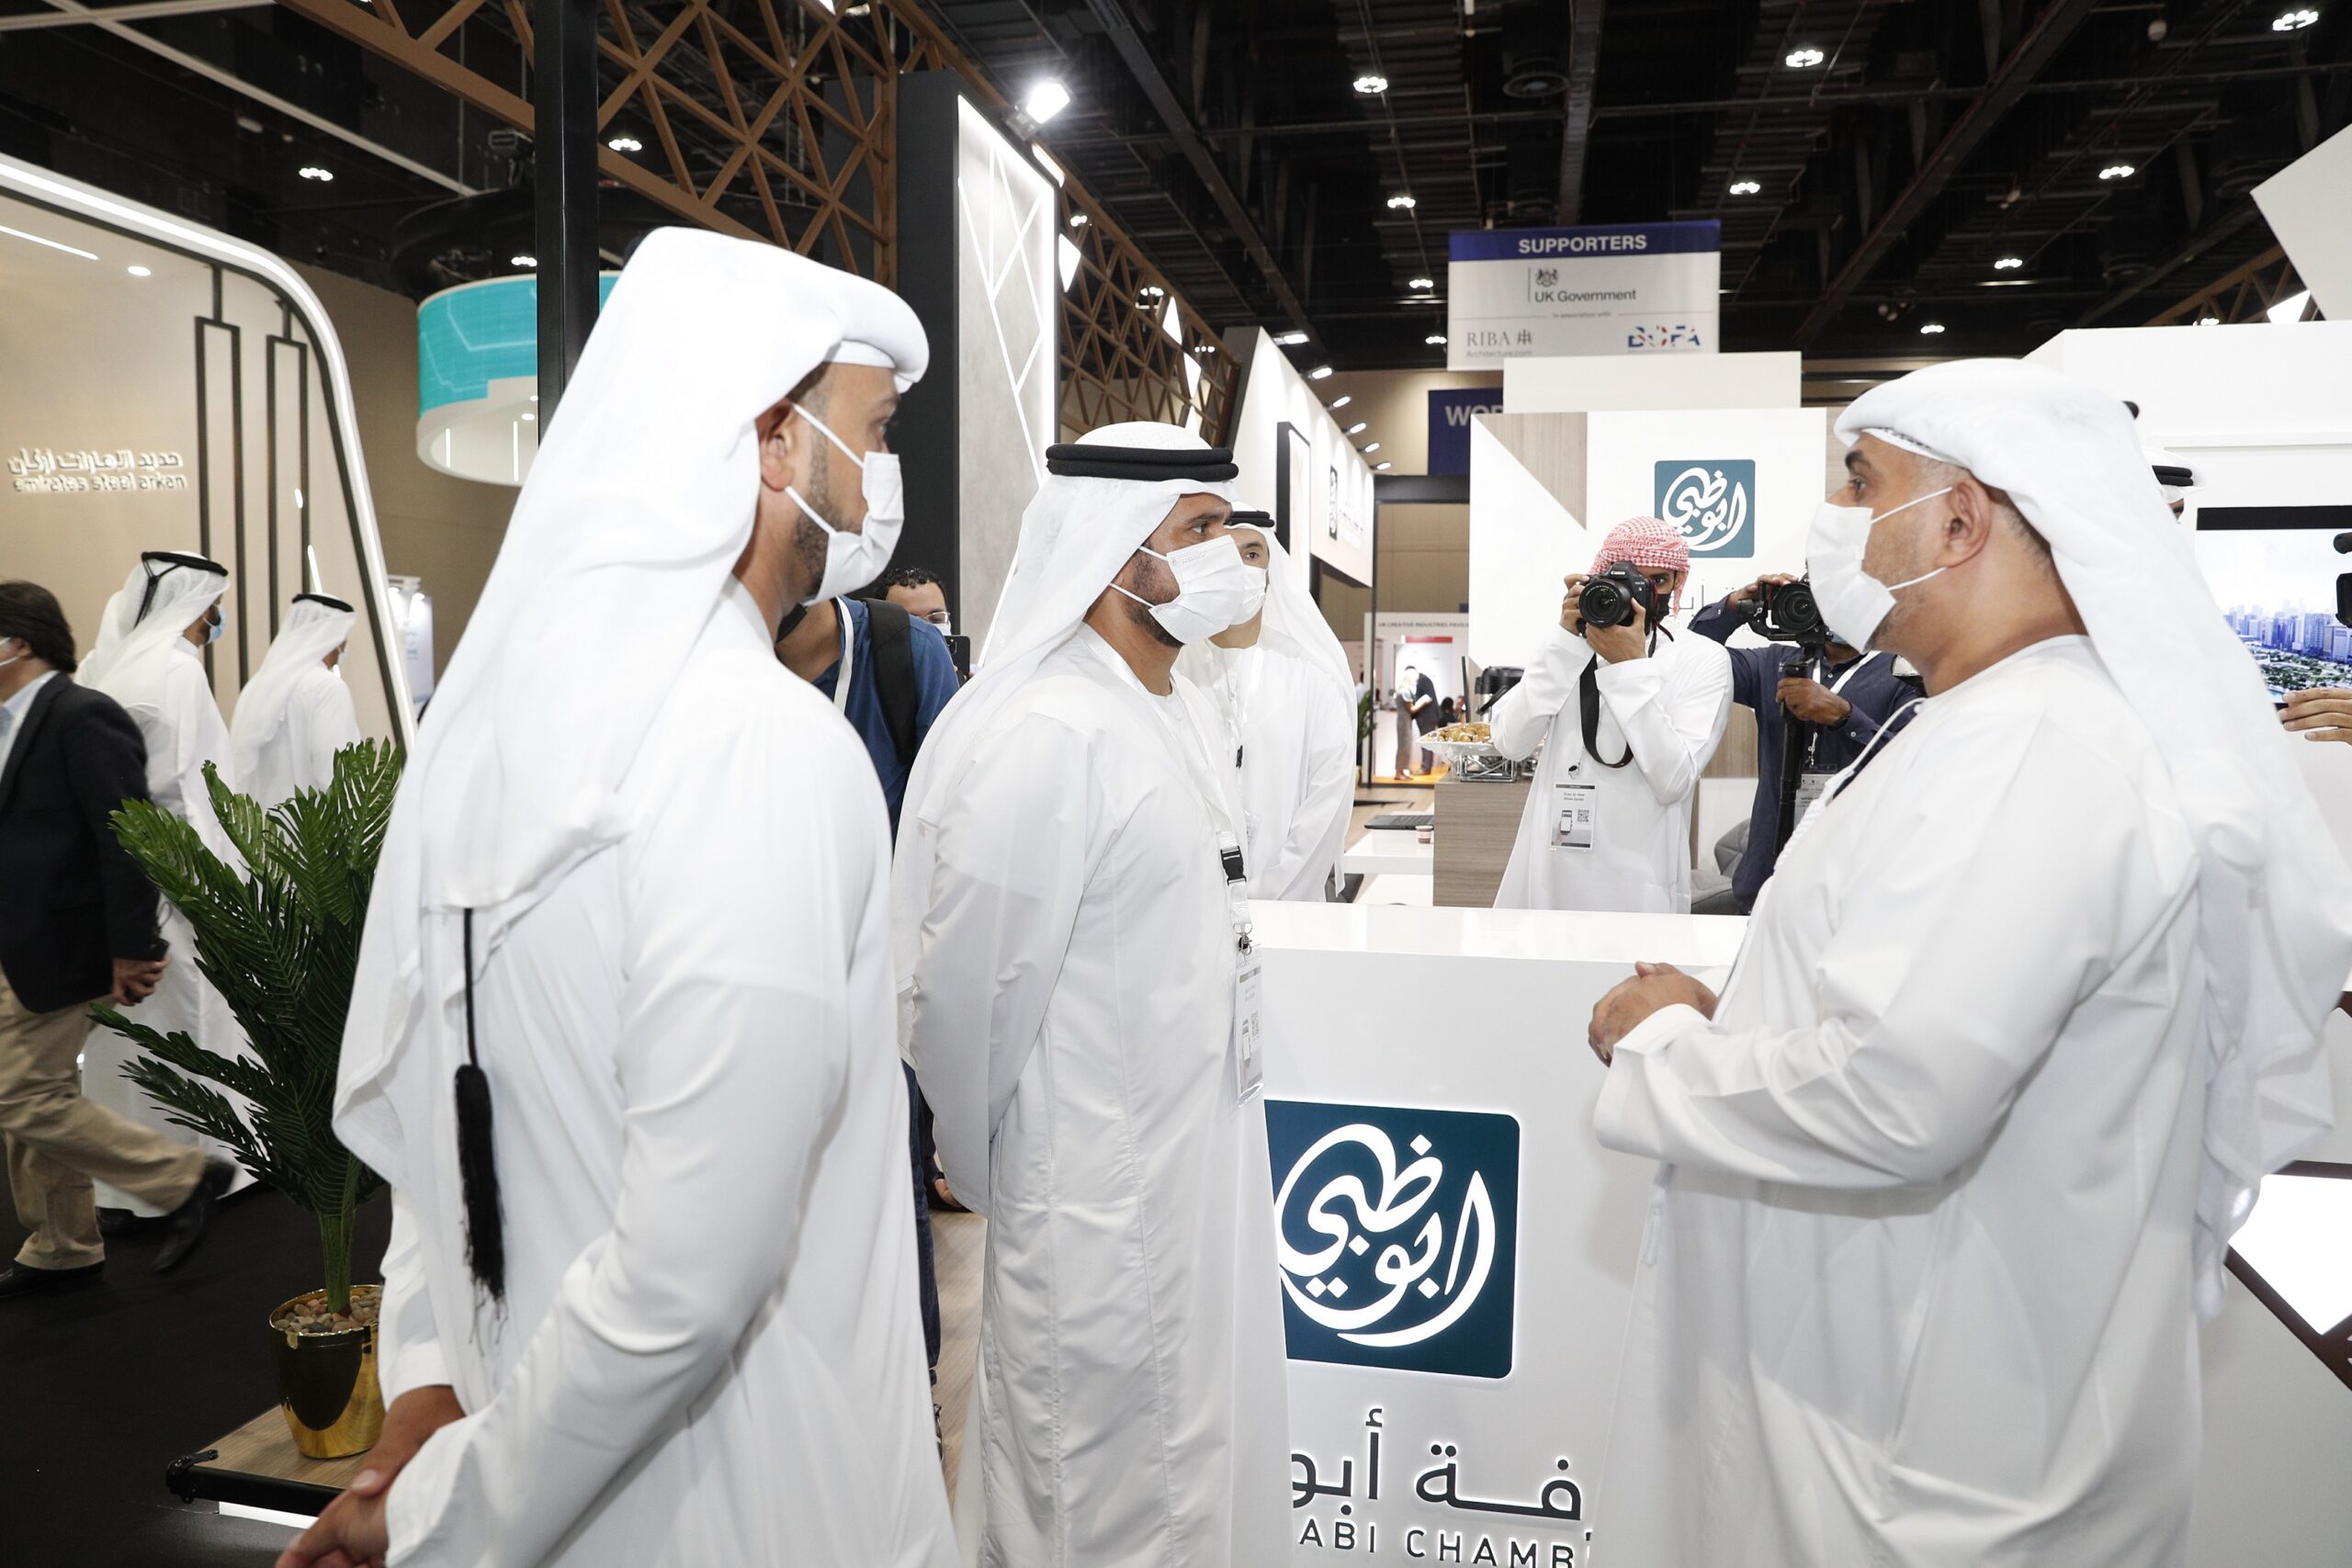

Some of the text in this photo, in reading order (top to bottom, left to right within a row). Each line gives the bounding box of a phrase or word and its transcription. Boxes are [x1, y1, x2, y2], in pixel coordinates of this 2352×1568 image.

[1518, 234, 1647, 254] SUPPORTERS
[1534, 289, 1637, 303] UK Government
[1466, 331, 1510, 346] RIBA
[1298, 1517, 1575, 1568] ABI CHAMB
